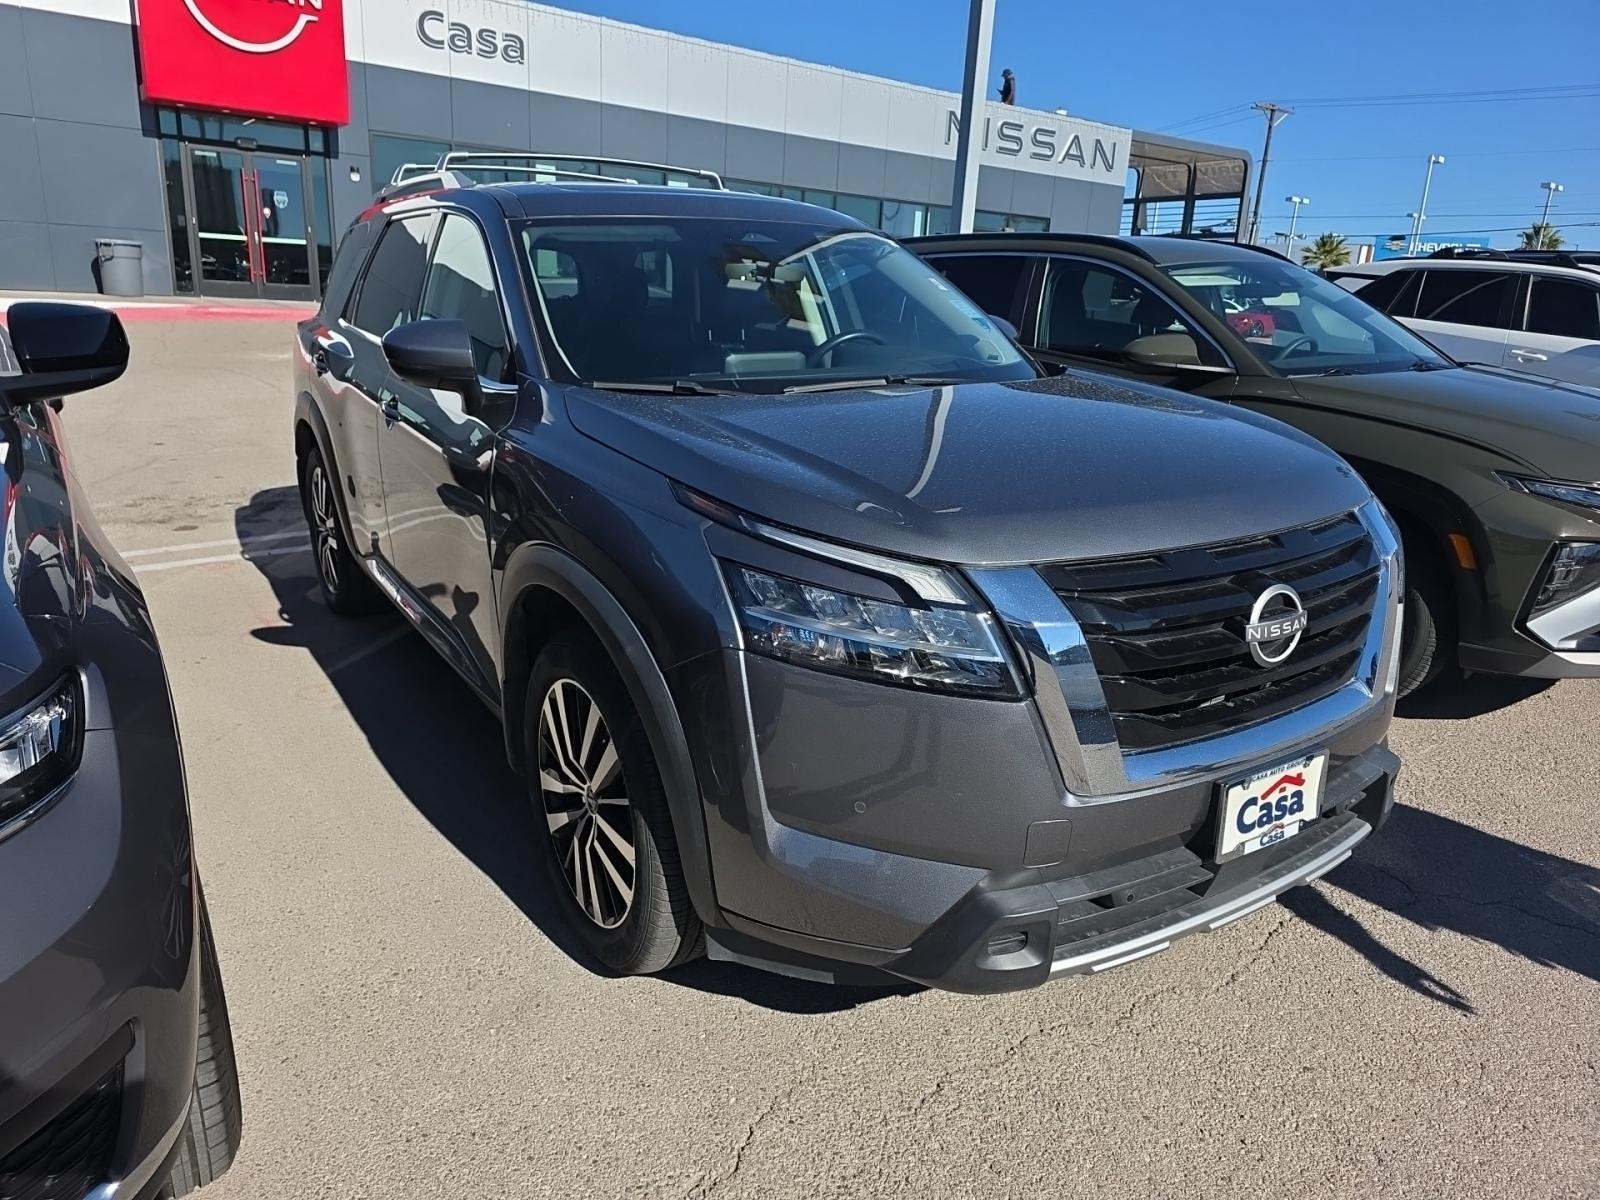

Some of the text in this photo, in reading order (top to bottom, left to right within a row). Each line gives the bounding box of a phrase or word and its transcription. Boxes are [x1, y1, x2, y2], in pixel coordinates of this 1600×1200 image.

[416, 10, 524, 65] Casa
[945, 110, 1117, 172] NISSAN
[1248, 614, 1307, 640] NISSAN
[1251, 772, 1268, 783] CASA
[1269, 767, 1286, 777] AUTO
[1236, 789, 1304, 835] Casa
[1260, 830, 1285, 847] Casa
